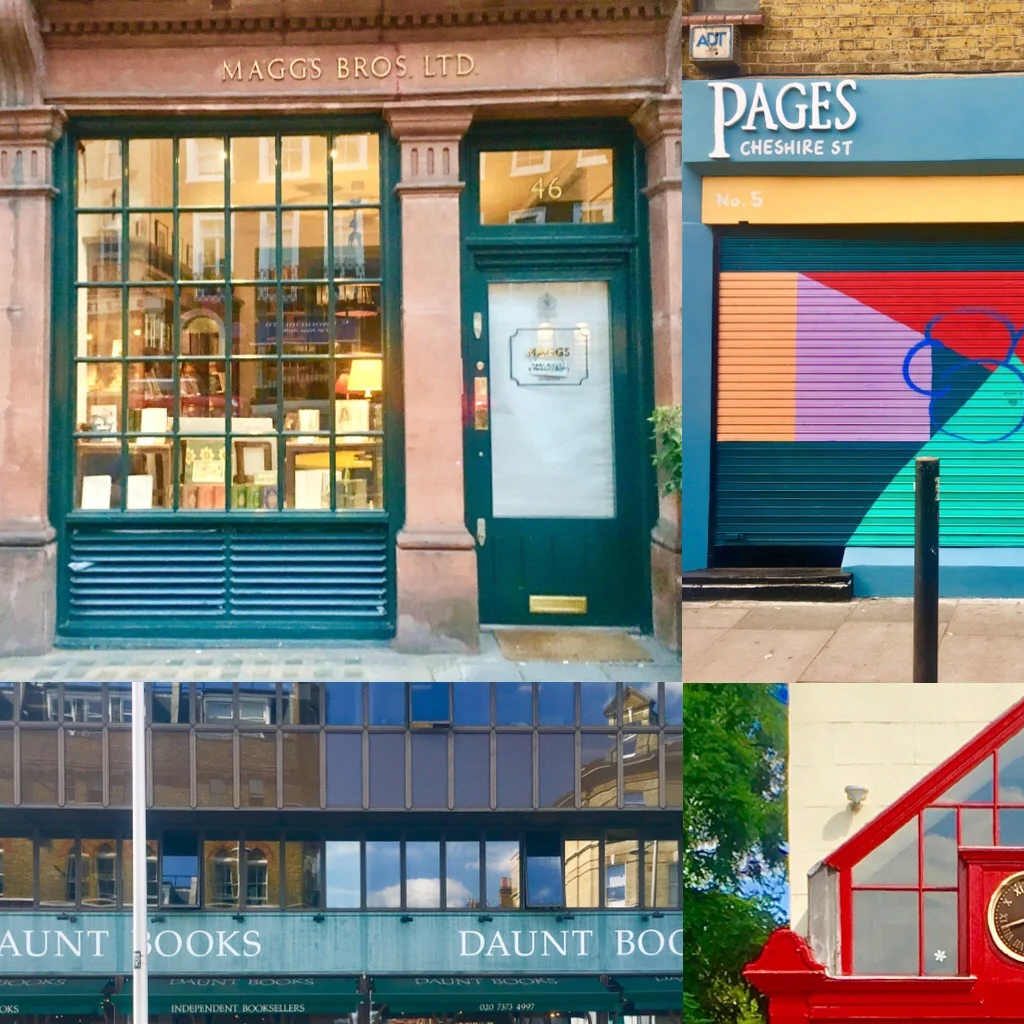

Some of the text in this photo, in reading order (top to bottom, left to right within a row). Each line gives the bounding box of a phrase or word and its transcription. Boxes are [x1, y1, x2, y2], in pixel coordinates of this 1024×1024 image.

[696, 32, 726, 47] ADT
[221, 53, 480, 81] MAGGS BROS. LTD.
[708, 79, 857, 159] PAGES
[740, 139, 853, 156] CHESHIRE ST
[531, 177, 562, 199] 46
[750, 191, 763, 207] 5
[0, 930, 262, 957] AUNT OOKS
[458, 930, 593, 957] DAUNT
[169, 978, 315, 986] DAUNT BOOKS
[414, 977, 558, 986] DAUNT BOOKS
[171, 1003, 305, 1013] INDEPENDENT BOOKSELLERS
[479, 1002, 536, 1012] 020 7373 4997
